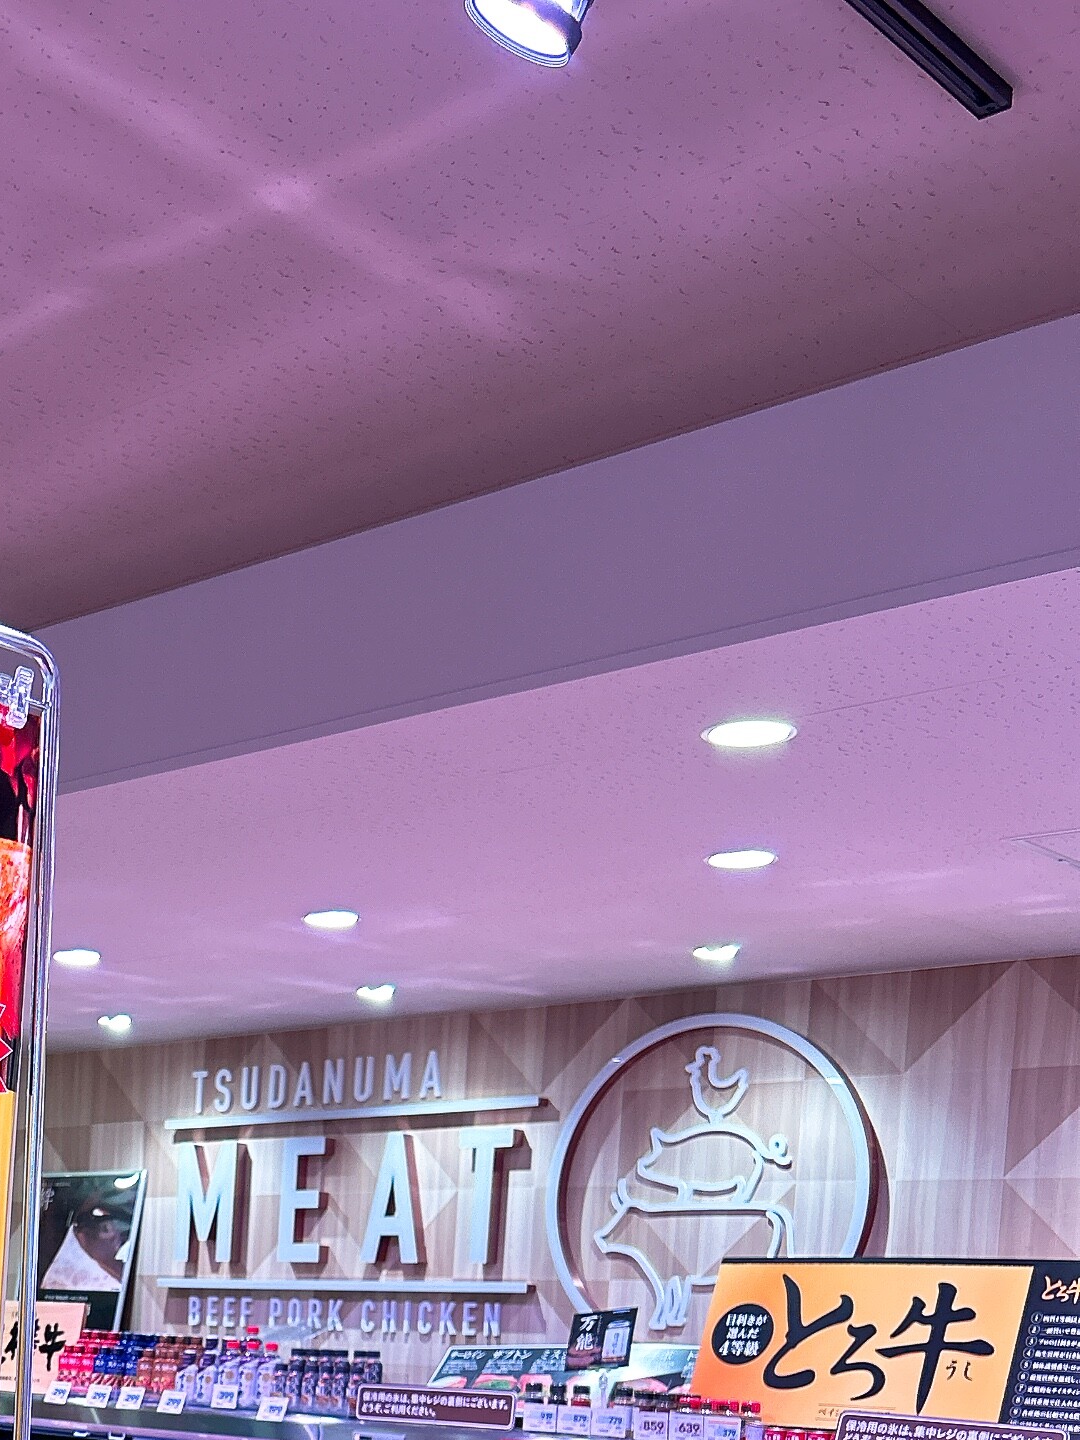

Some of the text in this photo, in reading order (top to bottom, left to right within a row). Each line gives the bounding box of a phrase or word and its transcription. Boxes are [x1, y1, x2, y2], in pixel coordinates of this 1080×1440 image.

[193, 1051, 443, 1114] TSUDANUMA
[172, 1126, 528, 1266] MEAT
[187, 1295, 502, 1338] BEEF PORK CHICKEN
[763, 1273, 996, 1417] とろ牛
[946, 1360, 972, 1381] うし
